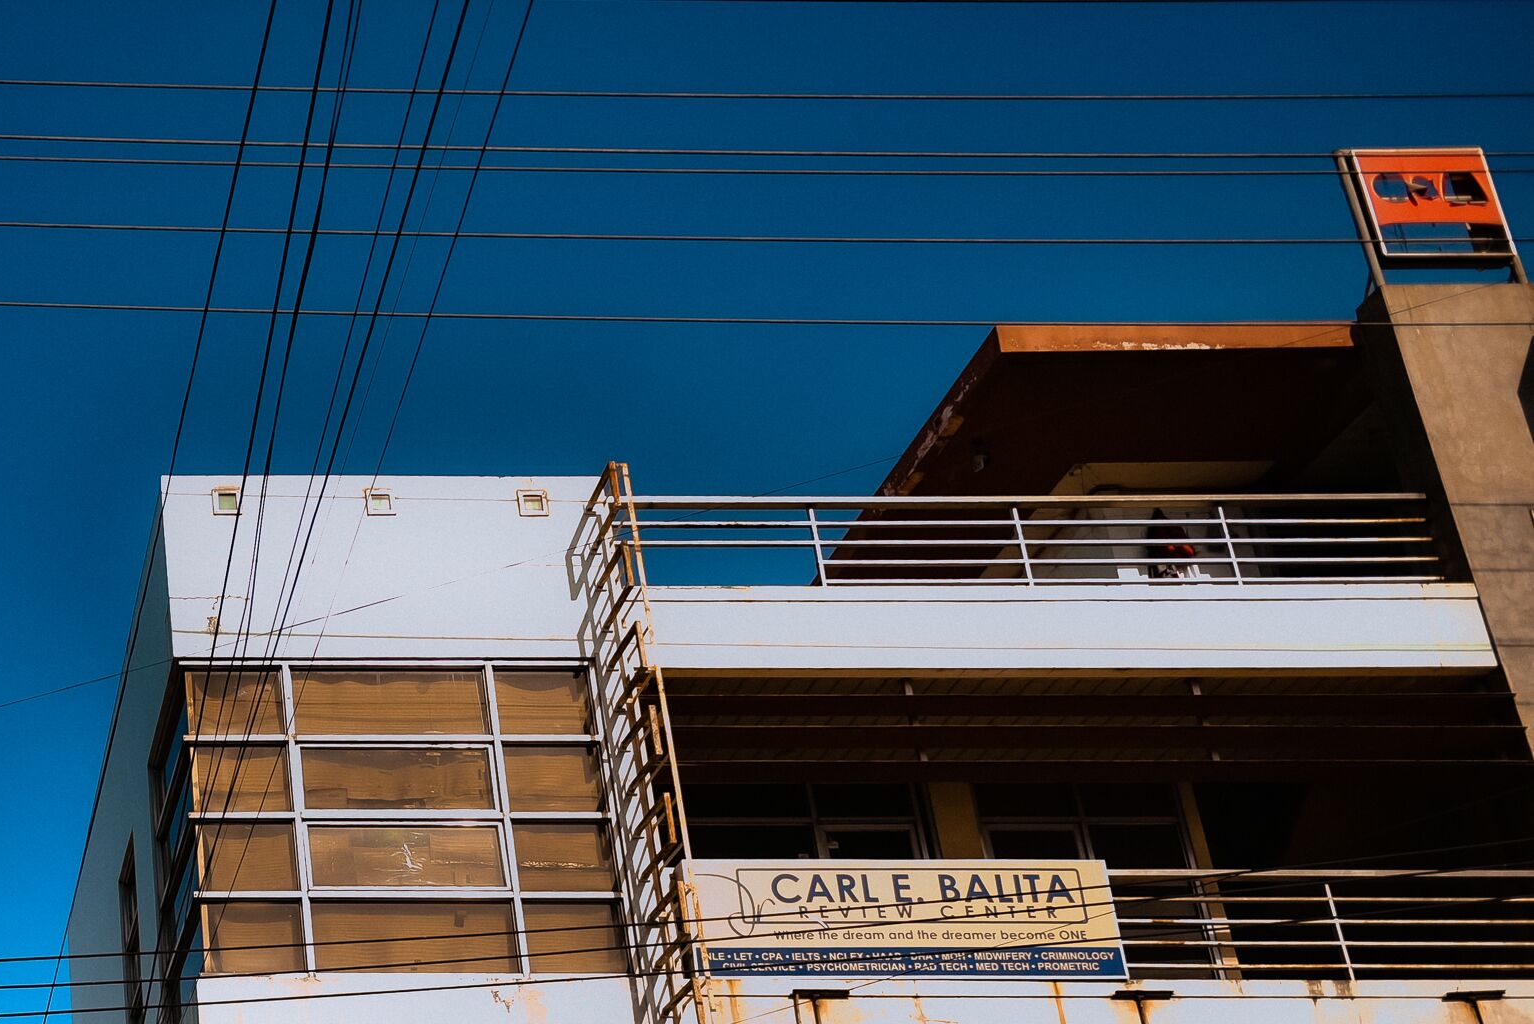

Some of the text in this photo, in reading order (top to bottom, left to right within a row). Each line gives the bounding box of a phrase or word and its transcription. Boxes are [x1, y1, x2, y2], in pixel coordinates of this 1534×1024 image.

[771, 874, 879, 903] CARL
[892, 875, 923, 903] E.
[938, 874, 1075, 903] BALITA
[799, 905, 1057, 918] REVIEW CENTER
[774, 930, 1087, 940] Where the dream and the dreamer become ONE
[733, 952, 753, 961] LET
[761, 952, 783, 961] CPA
[792, 952, 820, 961] IELTS
[974, 952, 1031, 961] MIDWIFERY
[1041, 952, 1114, 961] CRIMINOLOGY
[807, 962, 906, 971] PSYCHOMETRICIAN
[939, 962, 967, 971] TECH
[976, 962, 998, 971] MED
[1001, 962, 1030, 971] TECH
[1038, 962, 1100, 971] PROMETRIC
